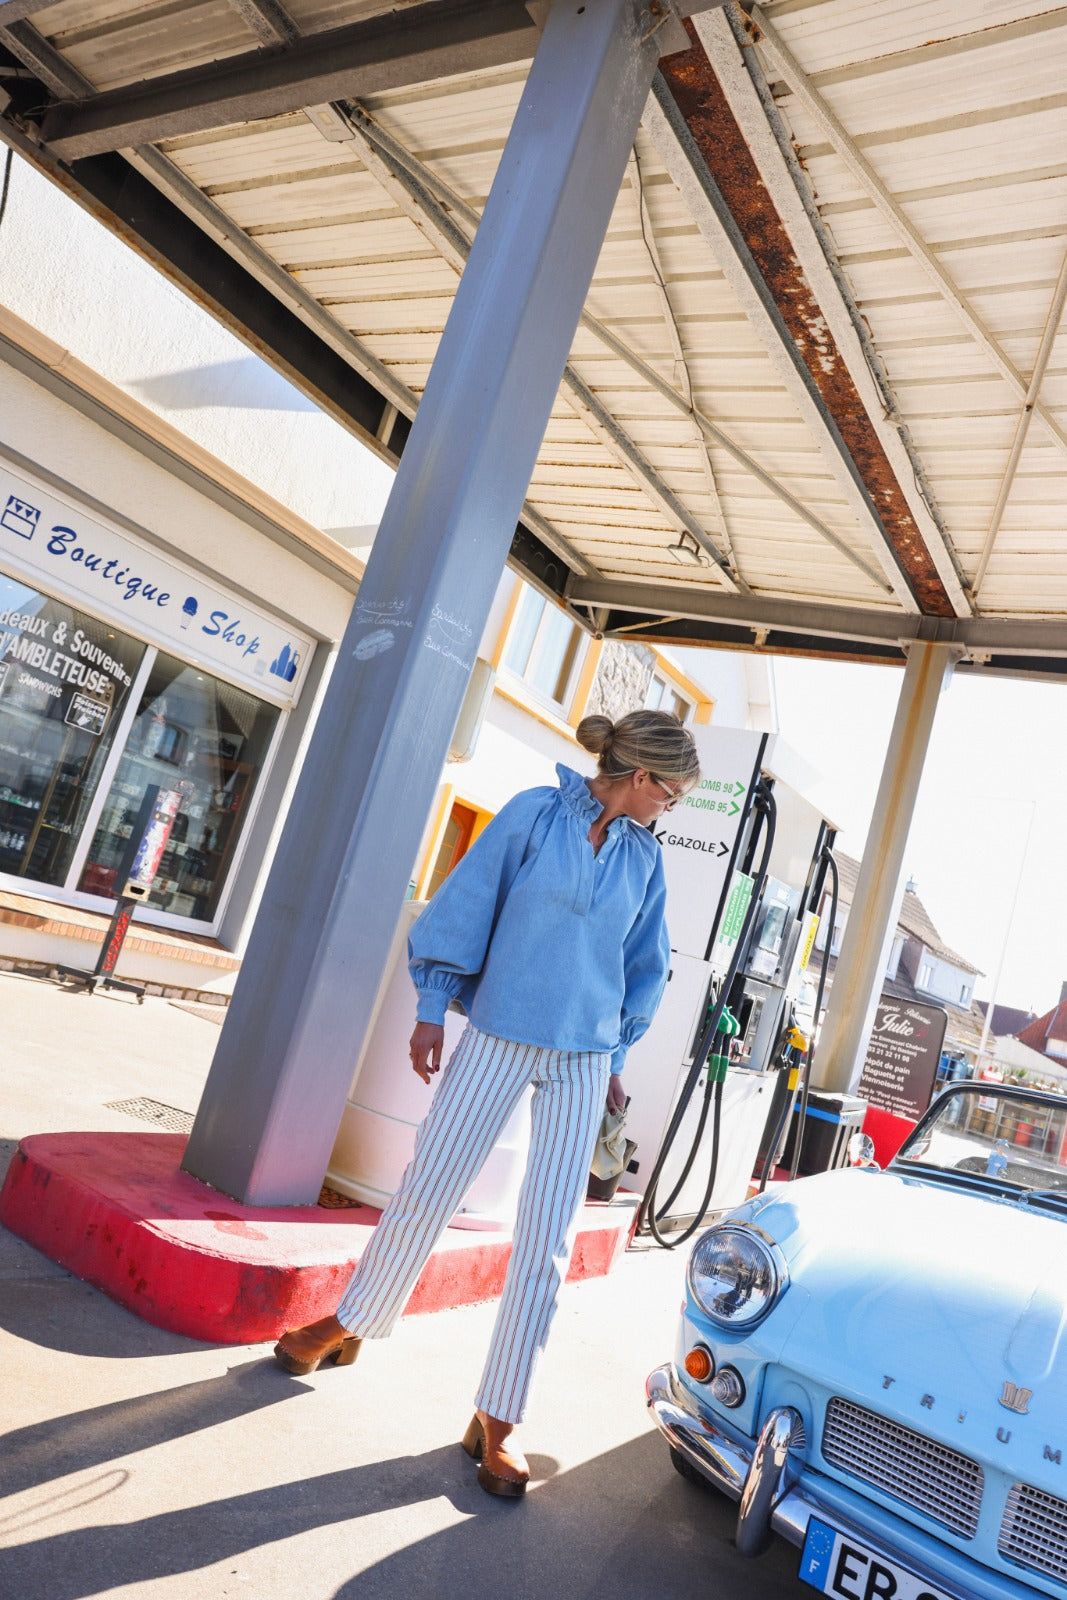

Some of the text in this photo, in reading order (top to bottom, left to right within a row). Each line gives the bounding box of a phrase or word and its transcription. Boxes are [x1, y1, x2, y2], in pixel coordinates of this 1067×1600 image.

[47, 525, 262, 657] Boutique Shop
[52, 621, 67, 646] &
[70, 630, 131, 687] Souvenirs
[18, 672, 62, 698] SANDWICHS
[698, 779, 734, 794] OMB 98
[680, 796, 728, 813] /PLOMB 95
[668, 834, 716, 853] GAZOLE
[873, 1013, 914, 1037] Julie
[876, 1048, 884, 1056] 21
[864, 1065, 896, 1080] Baguette
[884, 1062, 893, 1071] de
[894, 1066, 911, 1076] pain
[861, 1073, 904, 1092] Viennoiserie
[809, 1559, 821, 1574] F
